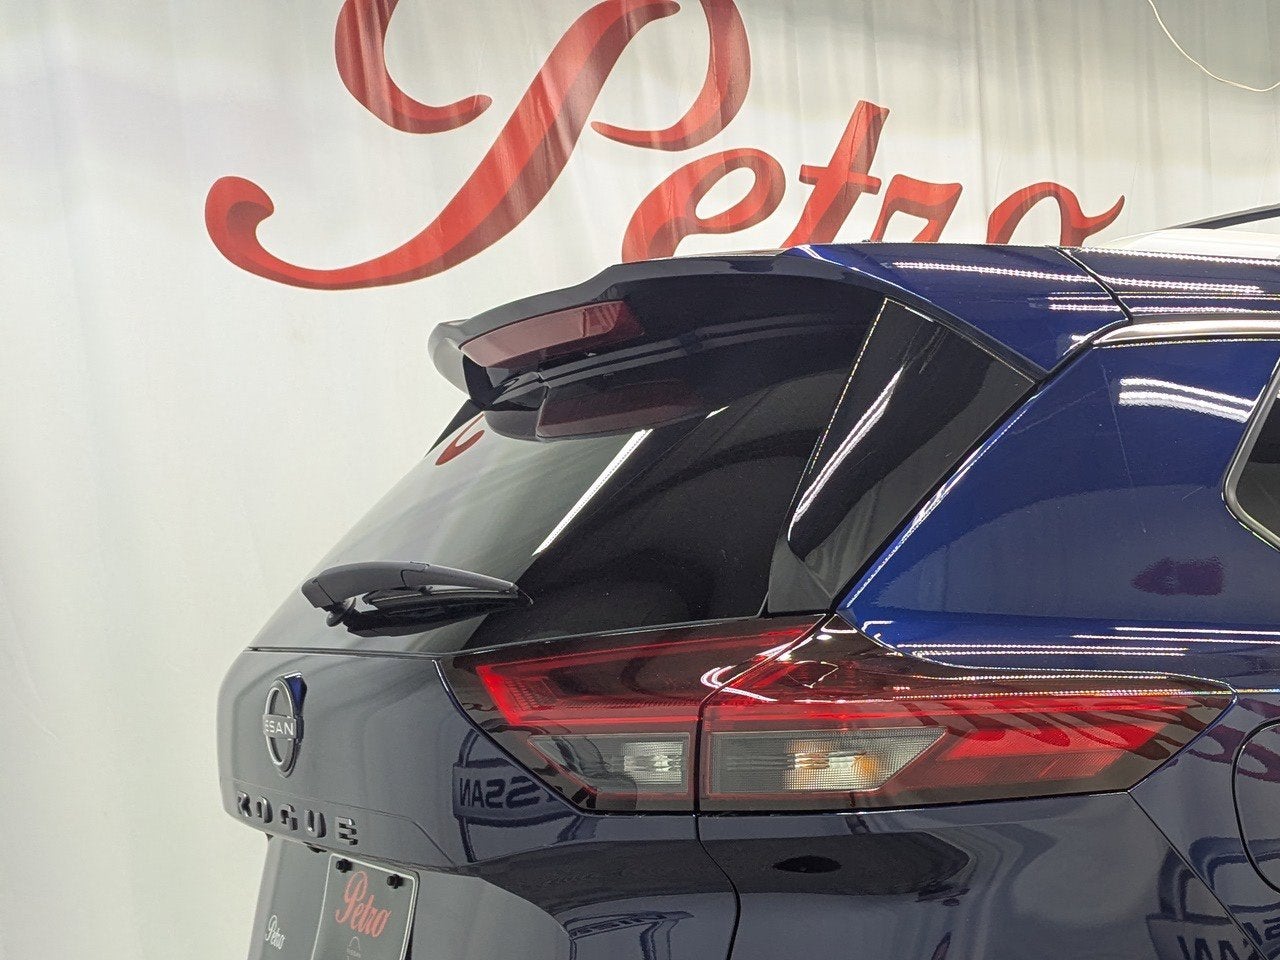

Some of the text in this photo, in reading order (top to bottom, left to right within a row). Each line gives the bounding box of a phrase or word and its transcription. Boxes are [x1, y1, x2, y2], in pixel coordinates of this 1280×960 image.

[236, 790, 359, 846] ROGUE
[265, 914, 286, 951] Petro
[334, 871, 392, 938] Petro
